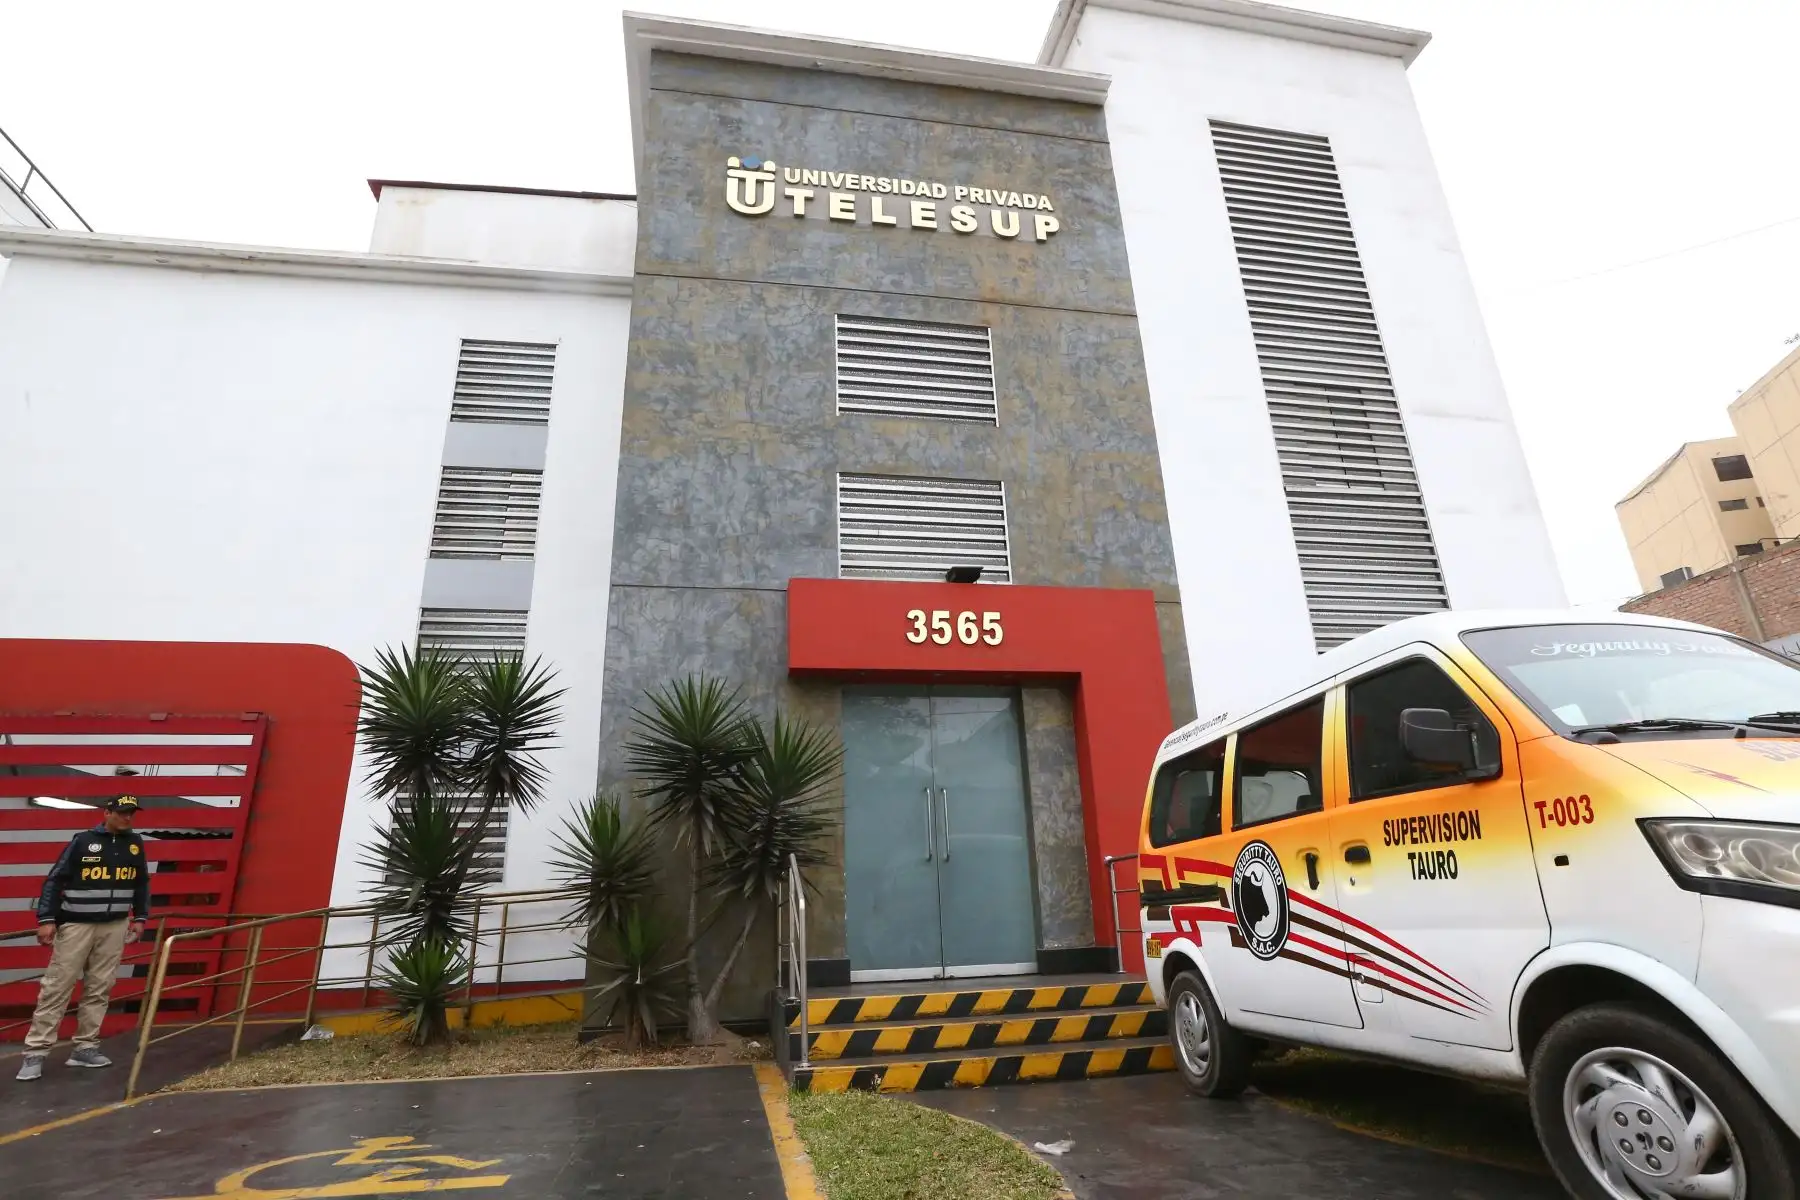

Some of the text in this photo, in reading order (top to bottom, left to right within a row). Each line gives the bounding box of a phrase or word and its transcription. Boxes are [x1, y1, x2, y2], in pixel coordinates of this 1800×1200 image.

[784, 167, 1054, 211] UNIVERSIDAD PRIVADA
[784, 187, 1061, 241] TELESUP
[906, 609, 1004, 646] 3565
[1383, 809, 1482, 847] SUPERVISION
[1534, 794, 1595, 829] T-003
[1234, 846, 1283, 886] SEGURITTY TAURO
[1407, 850, 1458, 880] TAURO
[1251, 937, 1275, 953] S.A.C.
